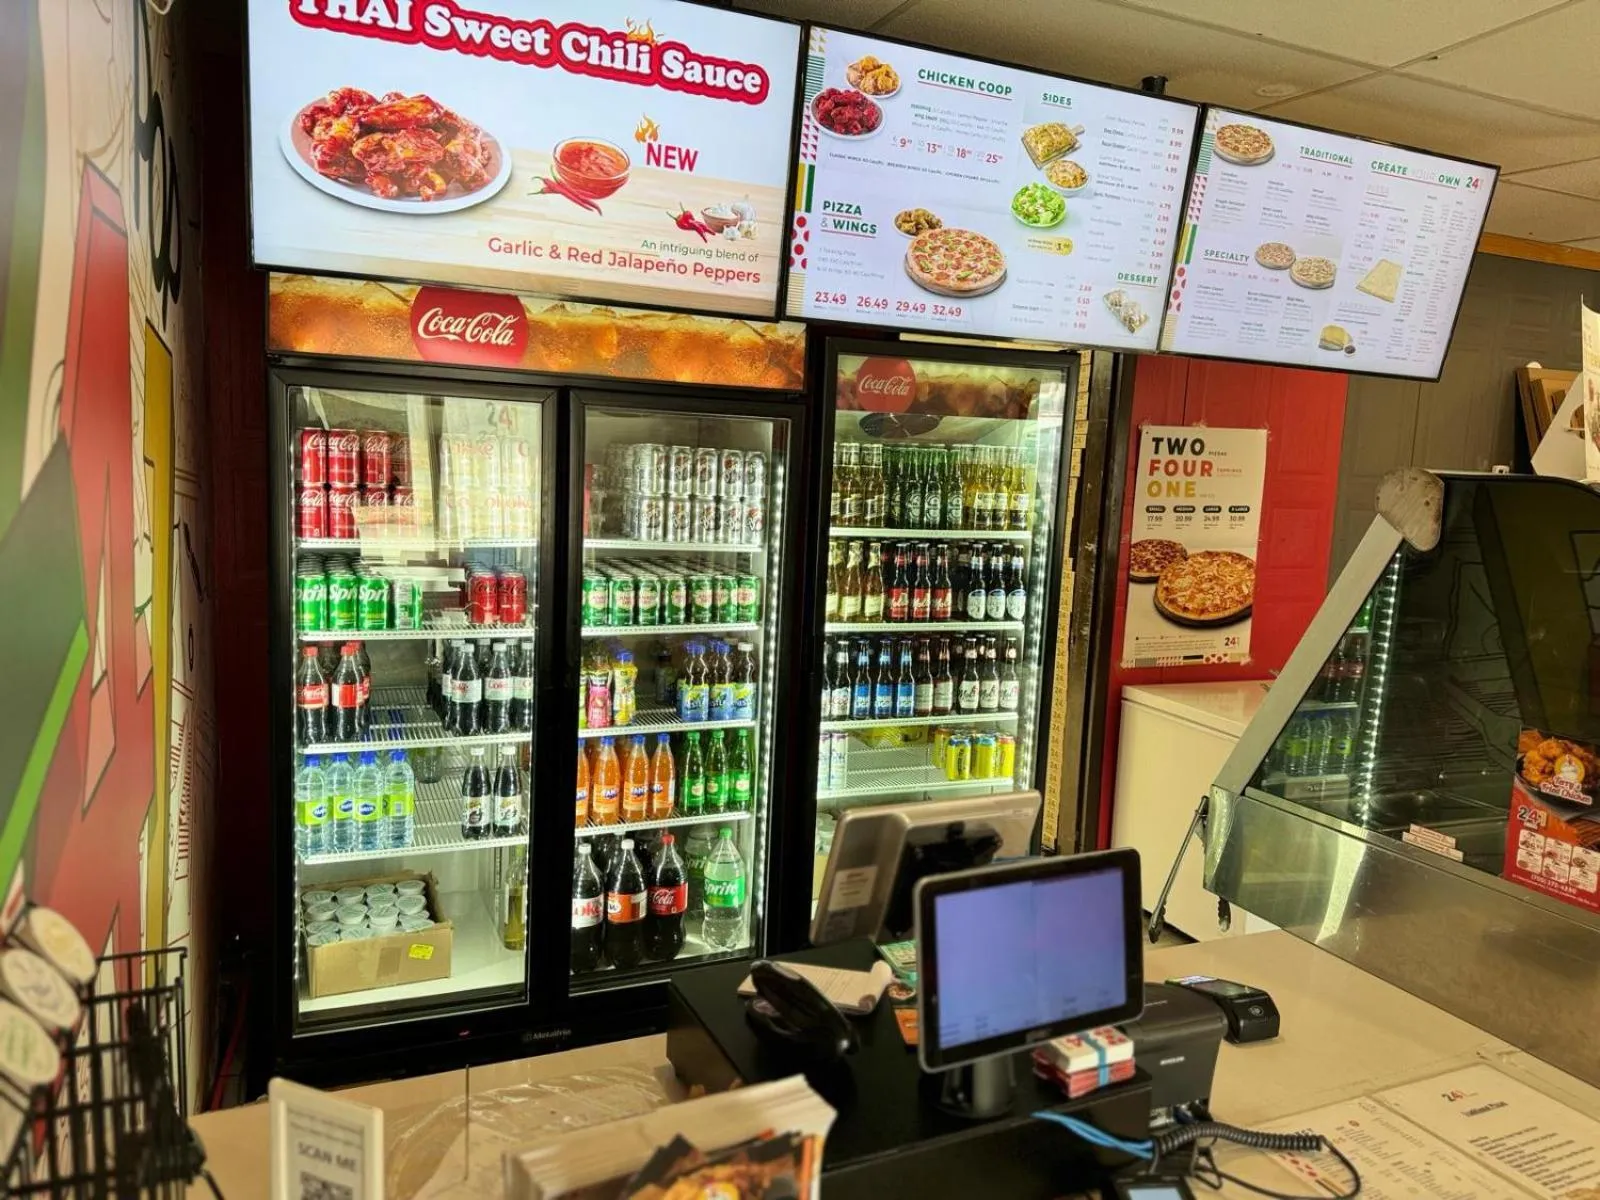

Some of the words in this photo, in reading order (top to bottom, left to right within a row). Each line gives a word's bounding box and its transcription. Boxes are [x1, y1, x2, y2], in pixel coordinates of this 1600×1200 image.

[424, 9, 551, 56] Sweet
[561, 30, 651, 75] Chili
[661, 49, 763, 94] Sauce
[917, 68, 975, 89] CHICKEN
[979, 81, 1012, 96] COOP
[1042, 92, 1072, 106] SIDES
[645, 142, 699, 172] NEW
[1300, 146, 1353, 164] TRADITIONAL
[1371, 160, 1409, 176] CREATE
[1438, 174, 1461, 187] OWN
[823, 201, 863, 216] PIZZA
[833, 219, 877, 234] WINGS
[641, 239, 657, 252] An
[660, 241, 713, 260] intriguing
[715, 248, 748, 261] blend
[750, 253, 760, 262] of
[1204, 249, 1250, 262] SPECIALTY
[487, 236, 543, 259] Garlic
[549, 244, 561, 259] &
[567, 246, 602, 264] Red
[608, 249, 688, 278] Jalapeño
[693, 262, 761, 284] Peppers
[1117, 272, 1159, 284] DESSERT
[815, 291, 847, 305] 23.49
[857, 296, 888, 310] 26.49
[896, 301, 926, 314] 29.49
[932, 304, 962, 317] 32.49
[417, 307, 515, 347] Coca-Cola
[859, 374, 912, 396] Coca-Cola
[1152, 437, 1205, 455] TWO
[1148, 459, 1213, 477] FOUR
[1147, 480, 1197, 498] ONE
